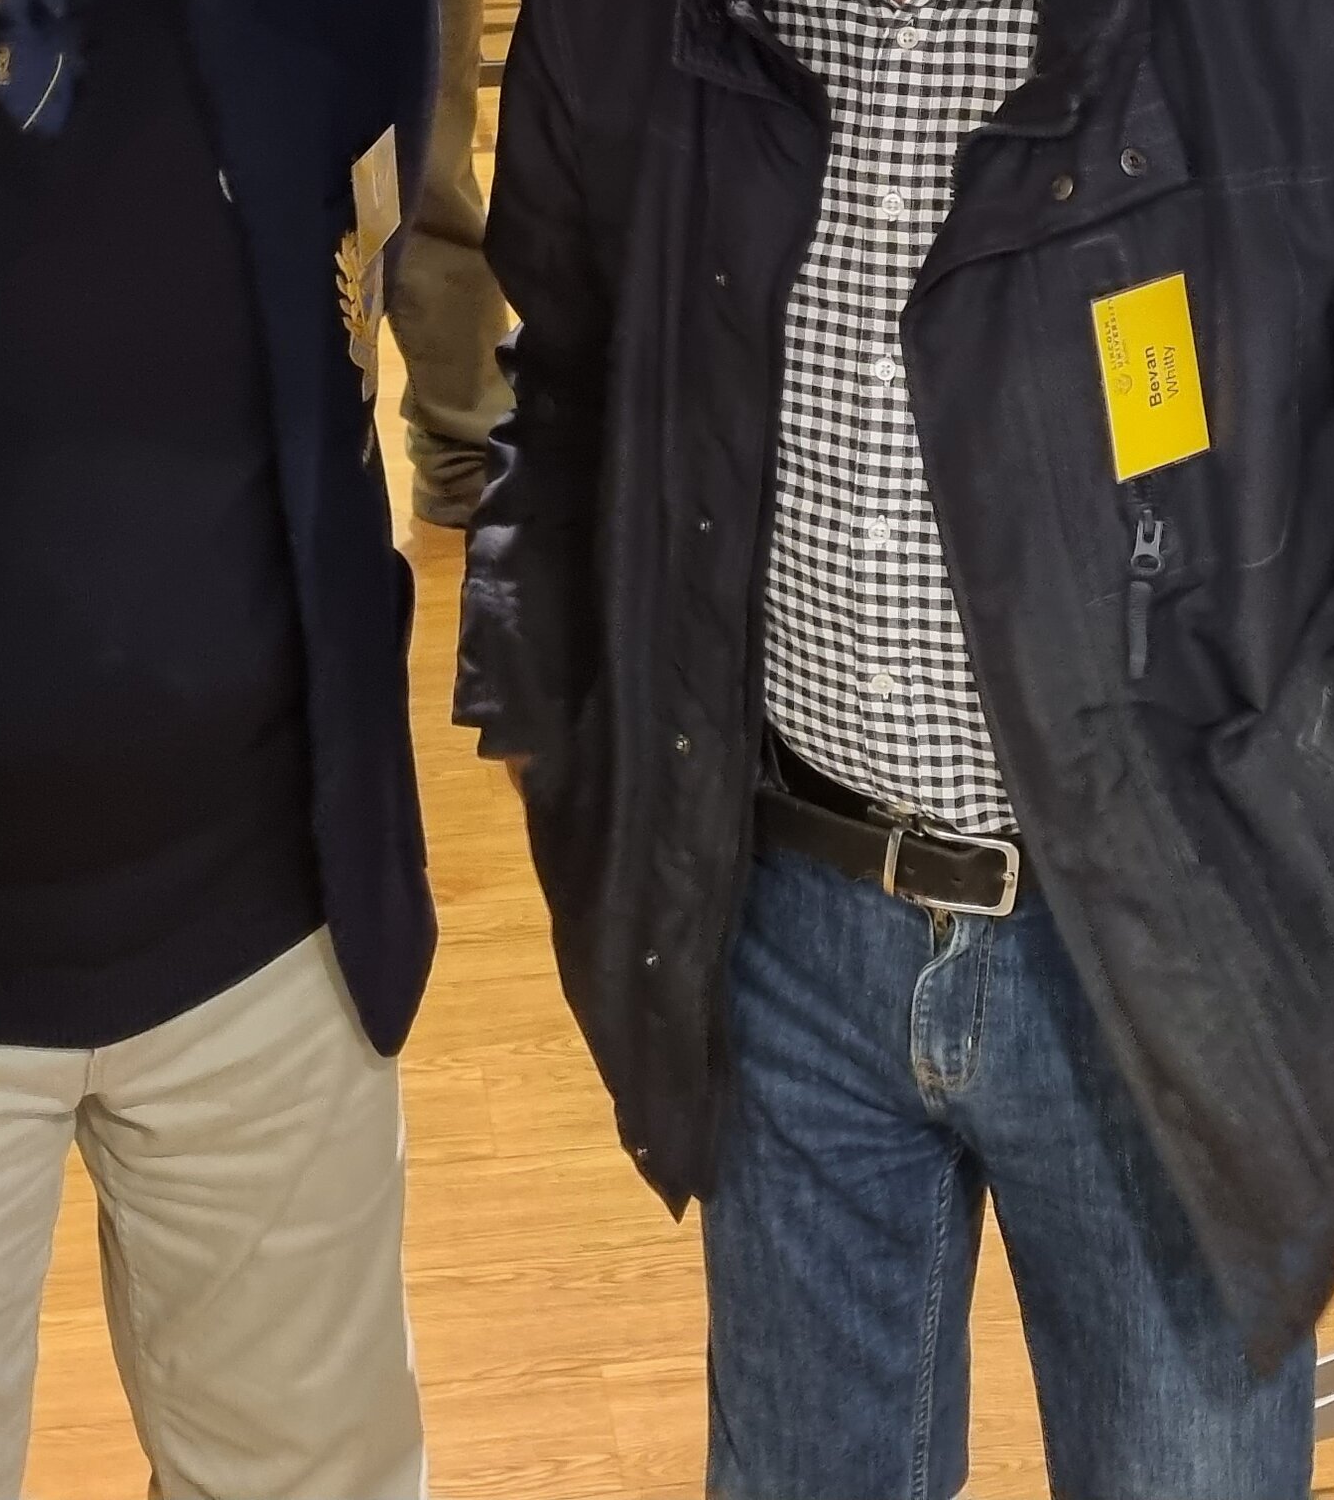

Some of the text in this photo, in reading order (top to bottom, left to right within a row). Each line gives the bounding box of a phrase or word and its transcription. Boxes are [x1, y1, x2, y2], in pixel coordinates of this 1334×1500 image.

[1104, 321, 1117, 371] LINCOLN
[1163, 346, 1179, 400] Whitty
[1145, 345, 1163, 408] Bevan
